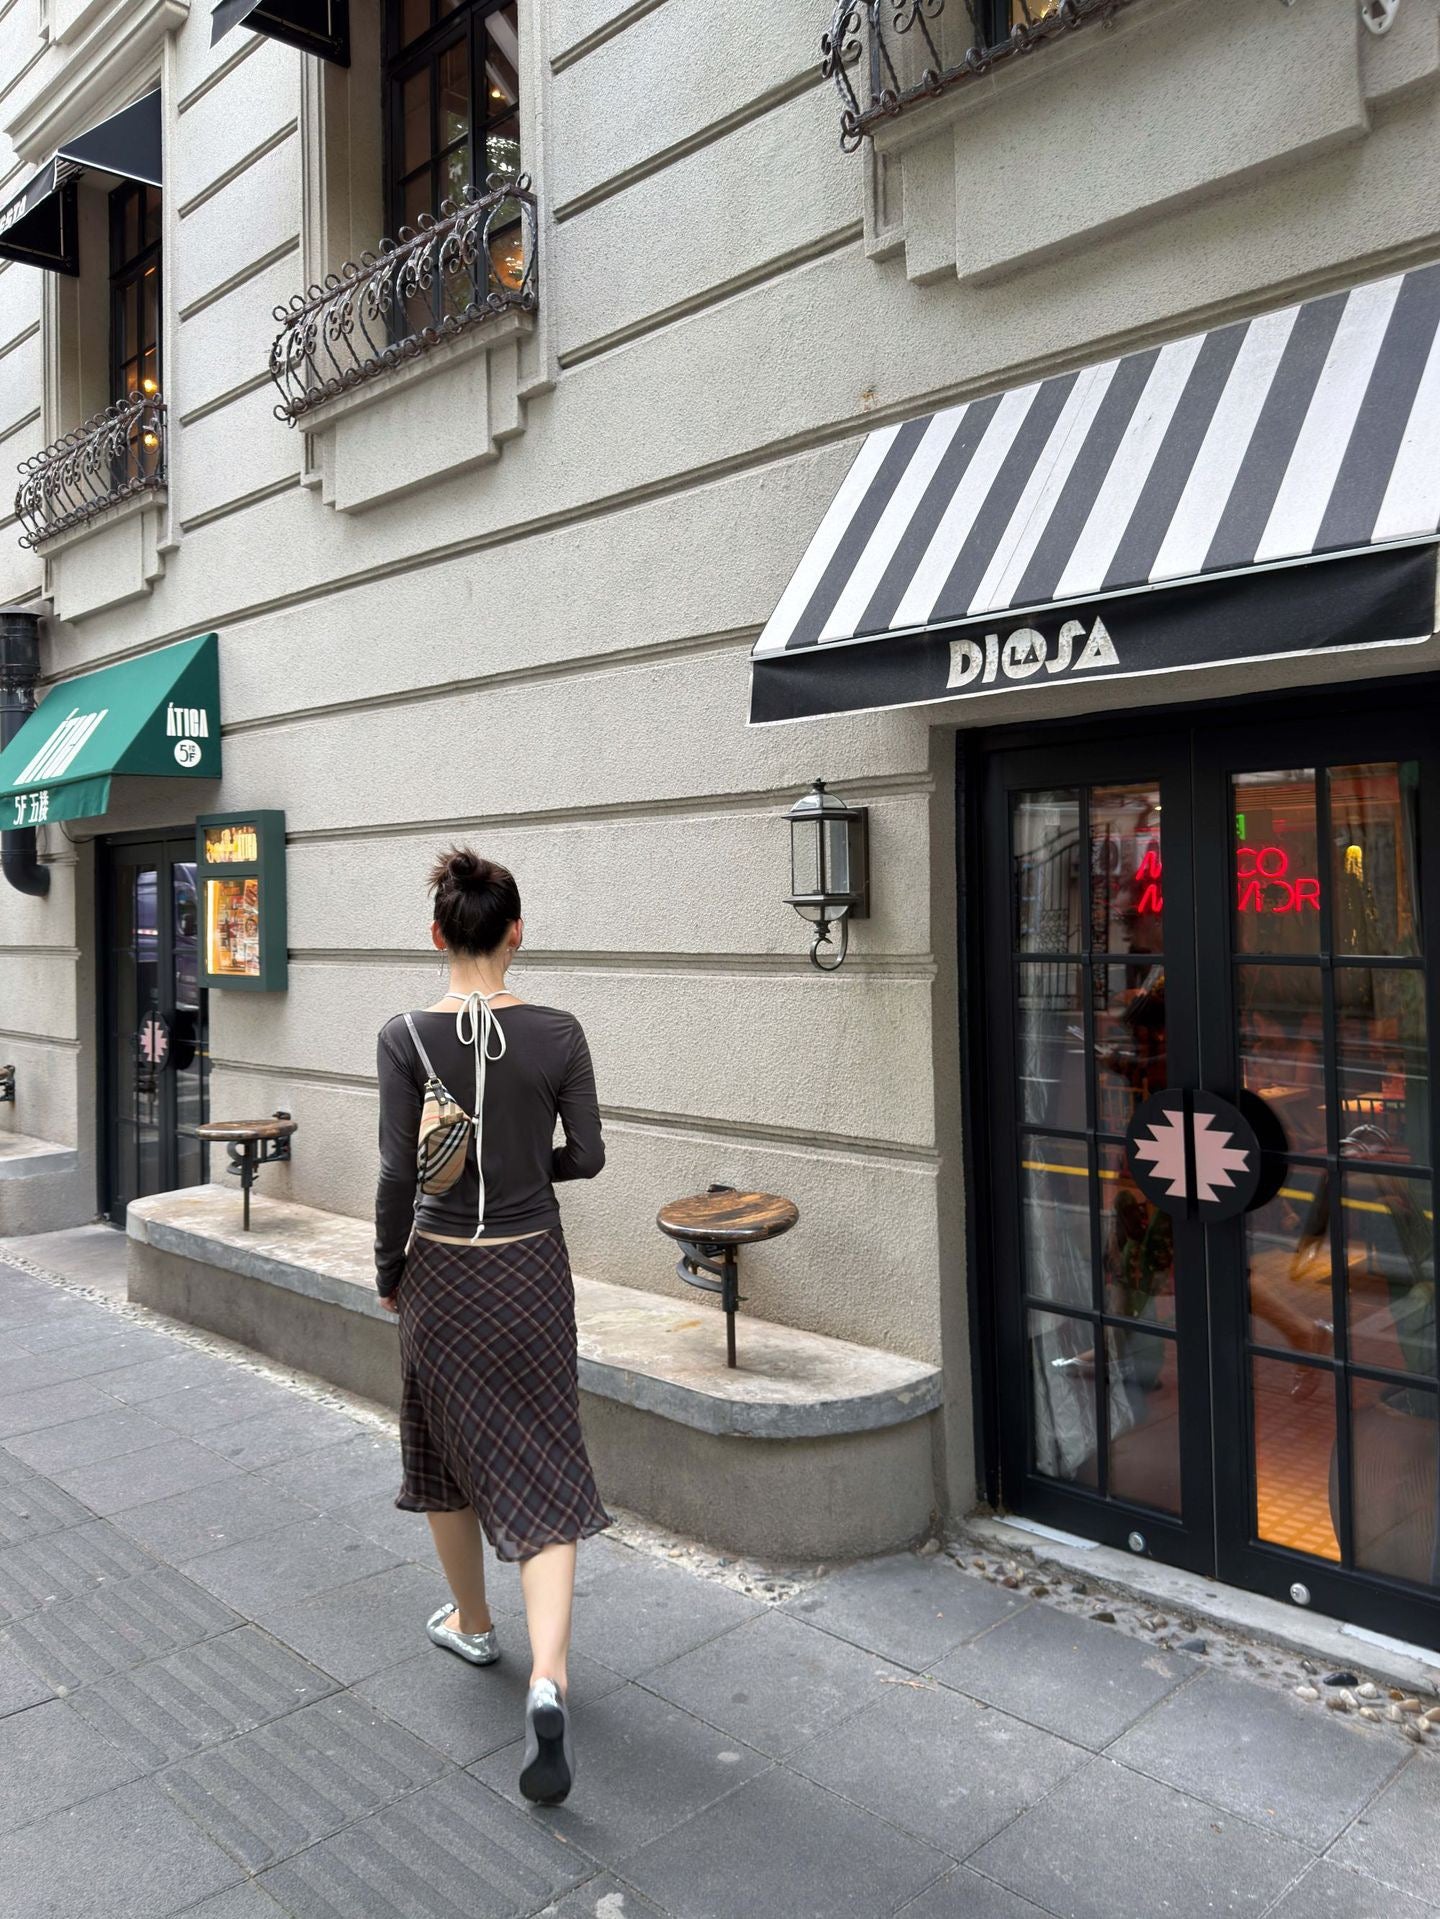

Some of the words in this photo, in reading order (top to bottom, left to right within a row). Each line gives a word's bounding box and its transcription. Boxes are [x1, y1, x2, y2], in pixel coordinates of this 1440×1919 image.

[946, 615, 1120, 688] DIOSA
[1009, 643, 1040, 667] LA
[166, 702, 209, 738] ÁTICA
